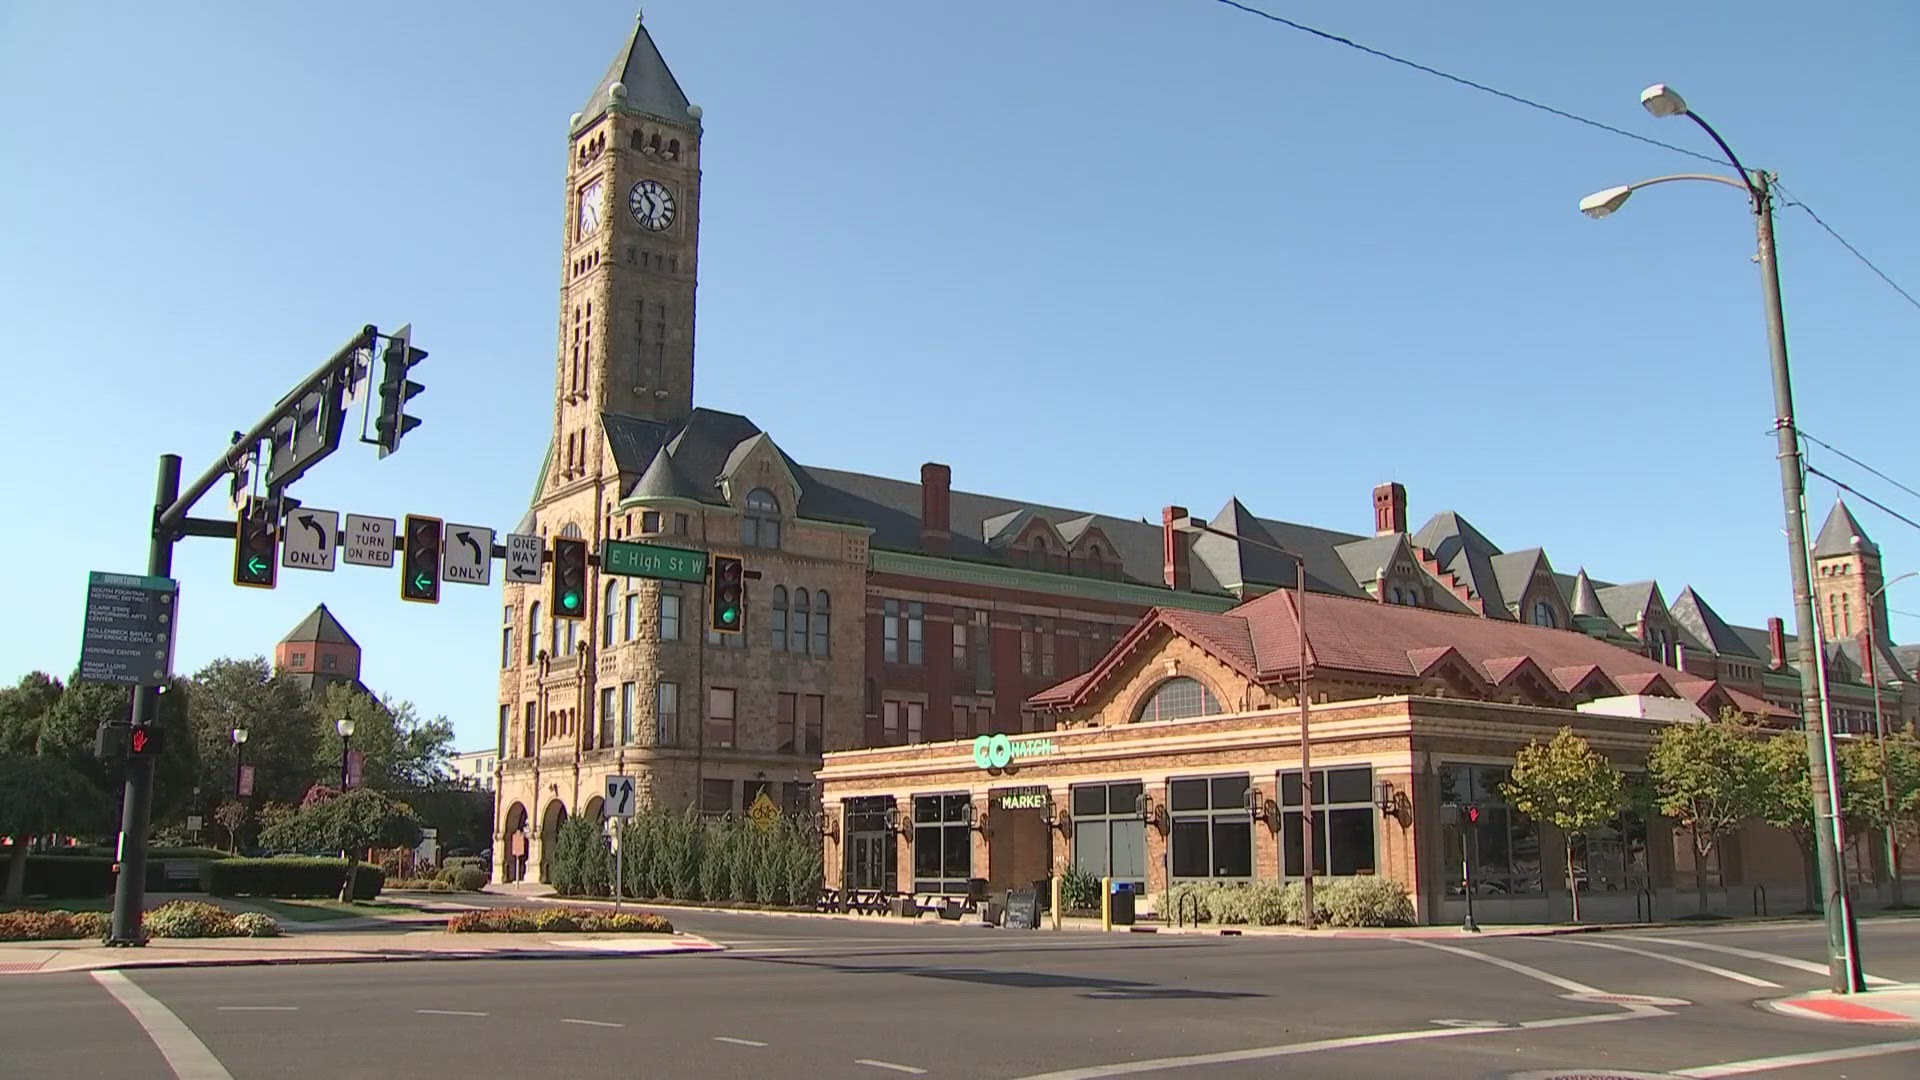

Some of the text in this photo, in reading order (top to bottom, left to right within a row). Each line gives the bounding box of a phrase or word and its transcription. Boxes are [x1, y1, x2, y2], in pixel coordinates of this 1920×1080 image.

[362, 522, 381, 533] NO
[355, 535, 385, 547] TURN
[513, 538, 537, 550] ONE
[290, 551, 329, 566] ONLY
[348, 547, 390, 562] ON RED
[512, 550, 537, 563] WAY
[612, 550, 703, 574] E High St W
[449, 565, 484, 580] ONLY
[91, 593, 120, 601] HISTORIC
[114, 589, 145, 597] FOUNTAIN
[89, 611, 130, 619] PERFORMING
[87, 627, 129, 635] HOLLENBECK
[86, 633, 128, 641] CONFERENCE
[85, 647, 115, 655] HERITAGE
